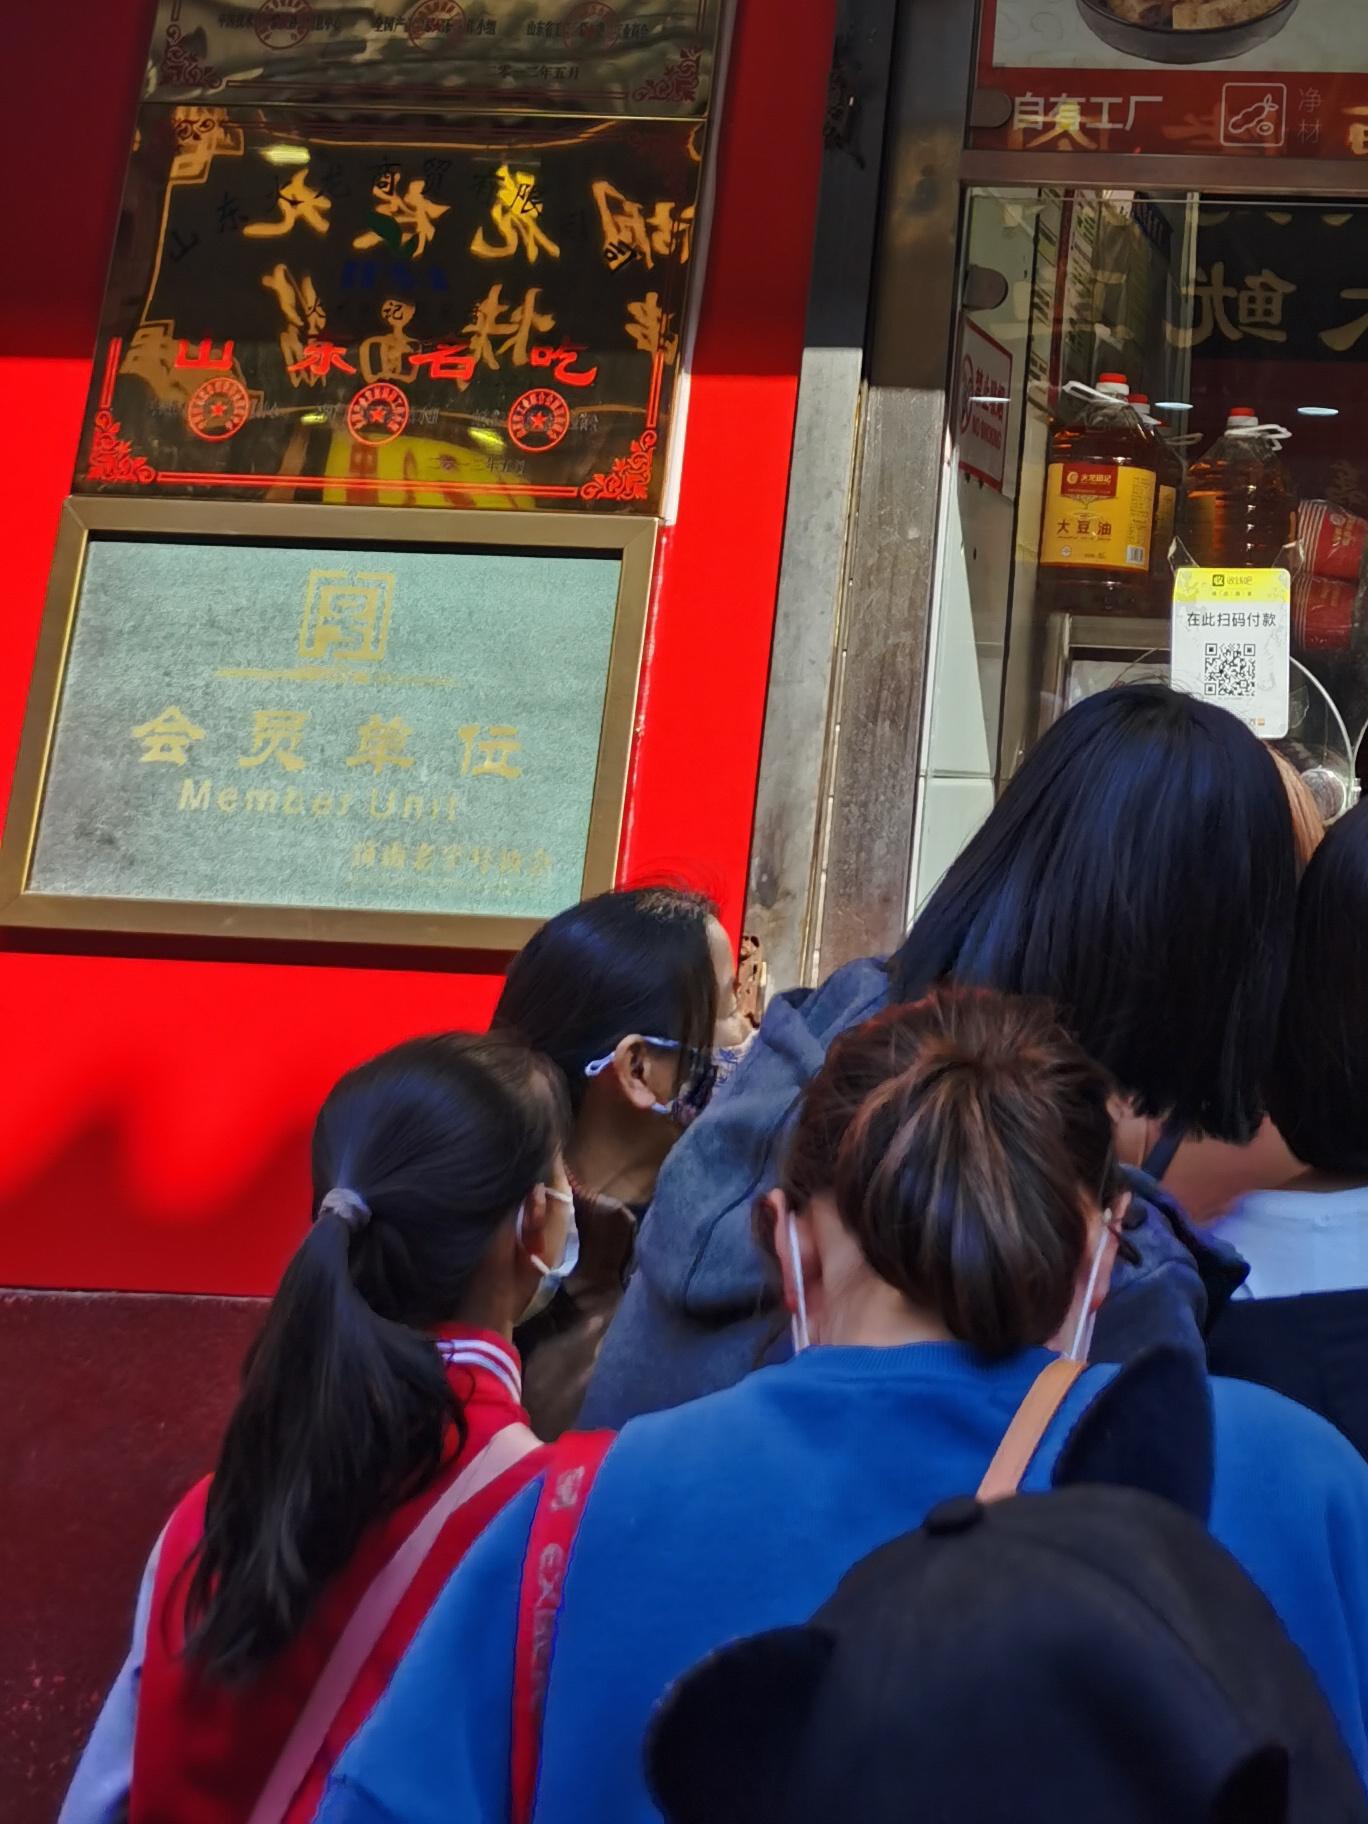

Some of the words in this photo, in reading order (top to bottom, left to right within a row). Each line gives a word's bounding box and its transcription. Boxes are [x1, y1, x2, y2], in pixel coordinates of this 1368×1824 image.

[1011, 90, 1164, 134] 自有工厂
[174, 337, 597, 385] 山东名吃
[1057, 520, 1112, 535] 大豆油
[1187, 612, 1276, 627] 在此扫码付款
[131, 705, 525, 778] 会员单位
